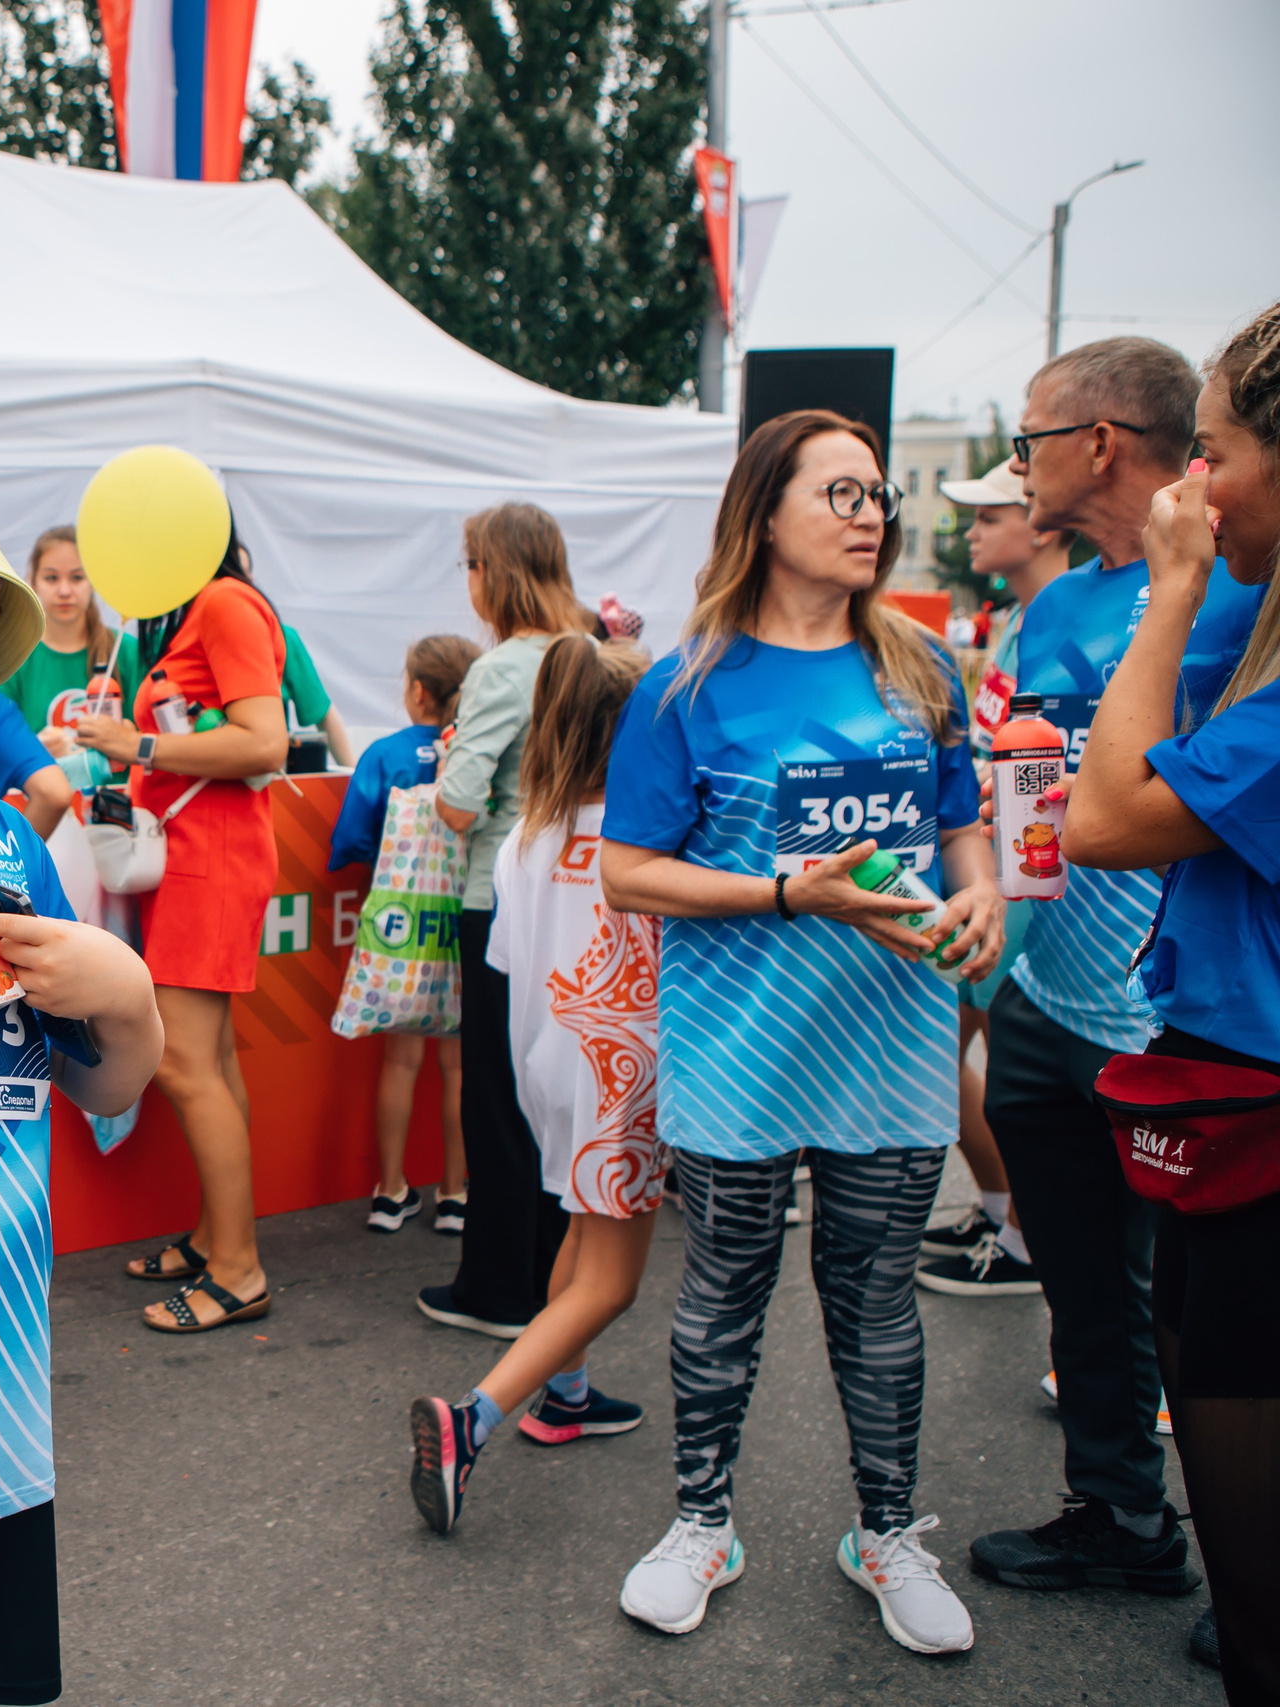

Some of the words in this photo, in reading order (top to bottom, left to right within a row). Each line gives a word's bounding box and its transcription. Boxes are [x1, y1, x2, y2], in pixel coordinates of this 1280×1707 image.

[800, 791, 921, 836] 3054
[1131, 1150, 1164, 1170] ЦВЕТОЧНЫЙ
[1163, 1161, 1194, 1176] ЗАБЕГ
